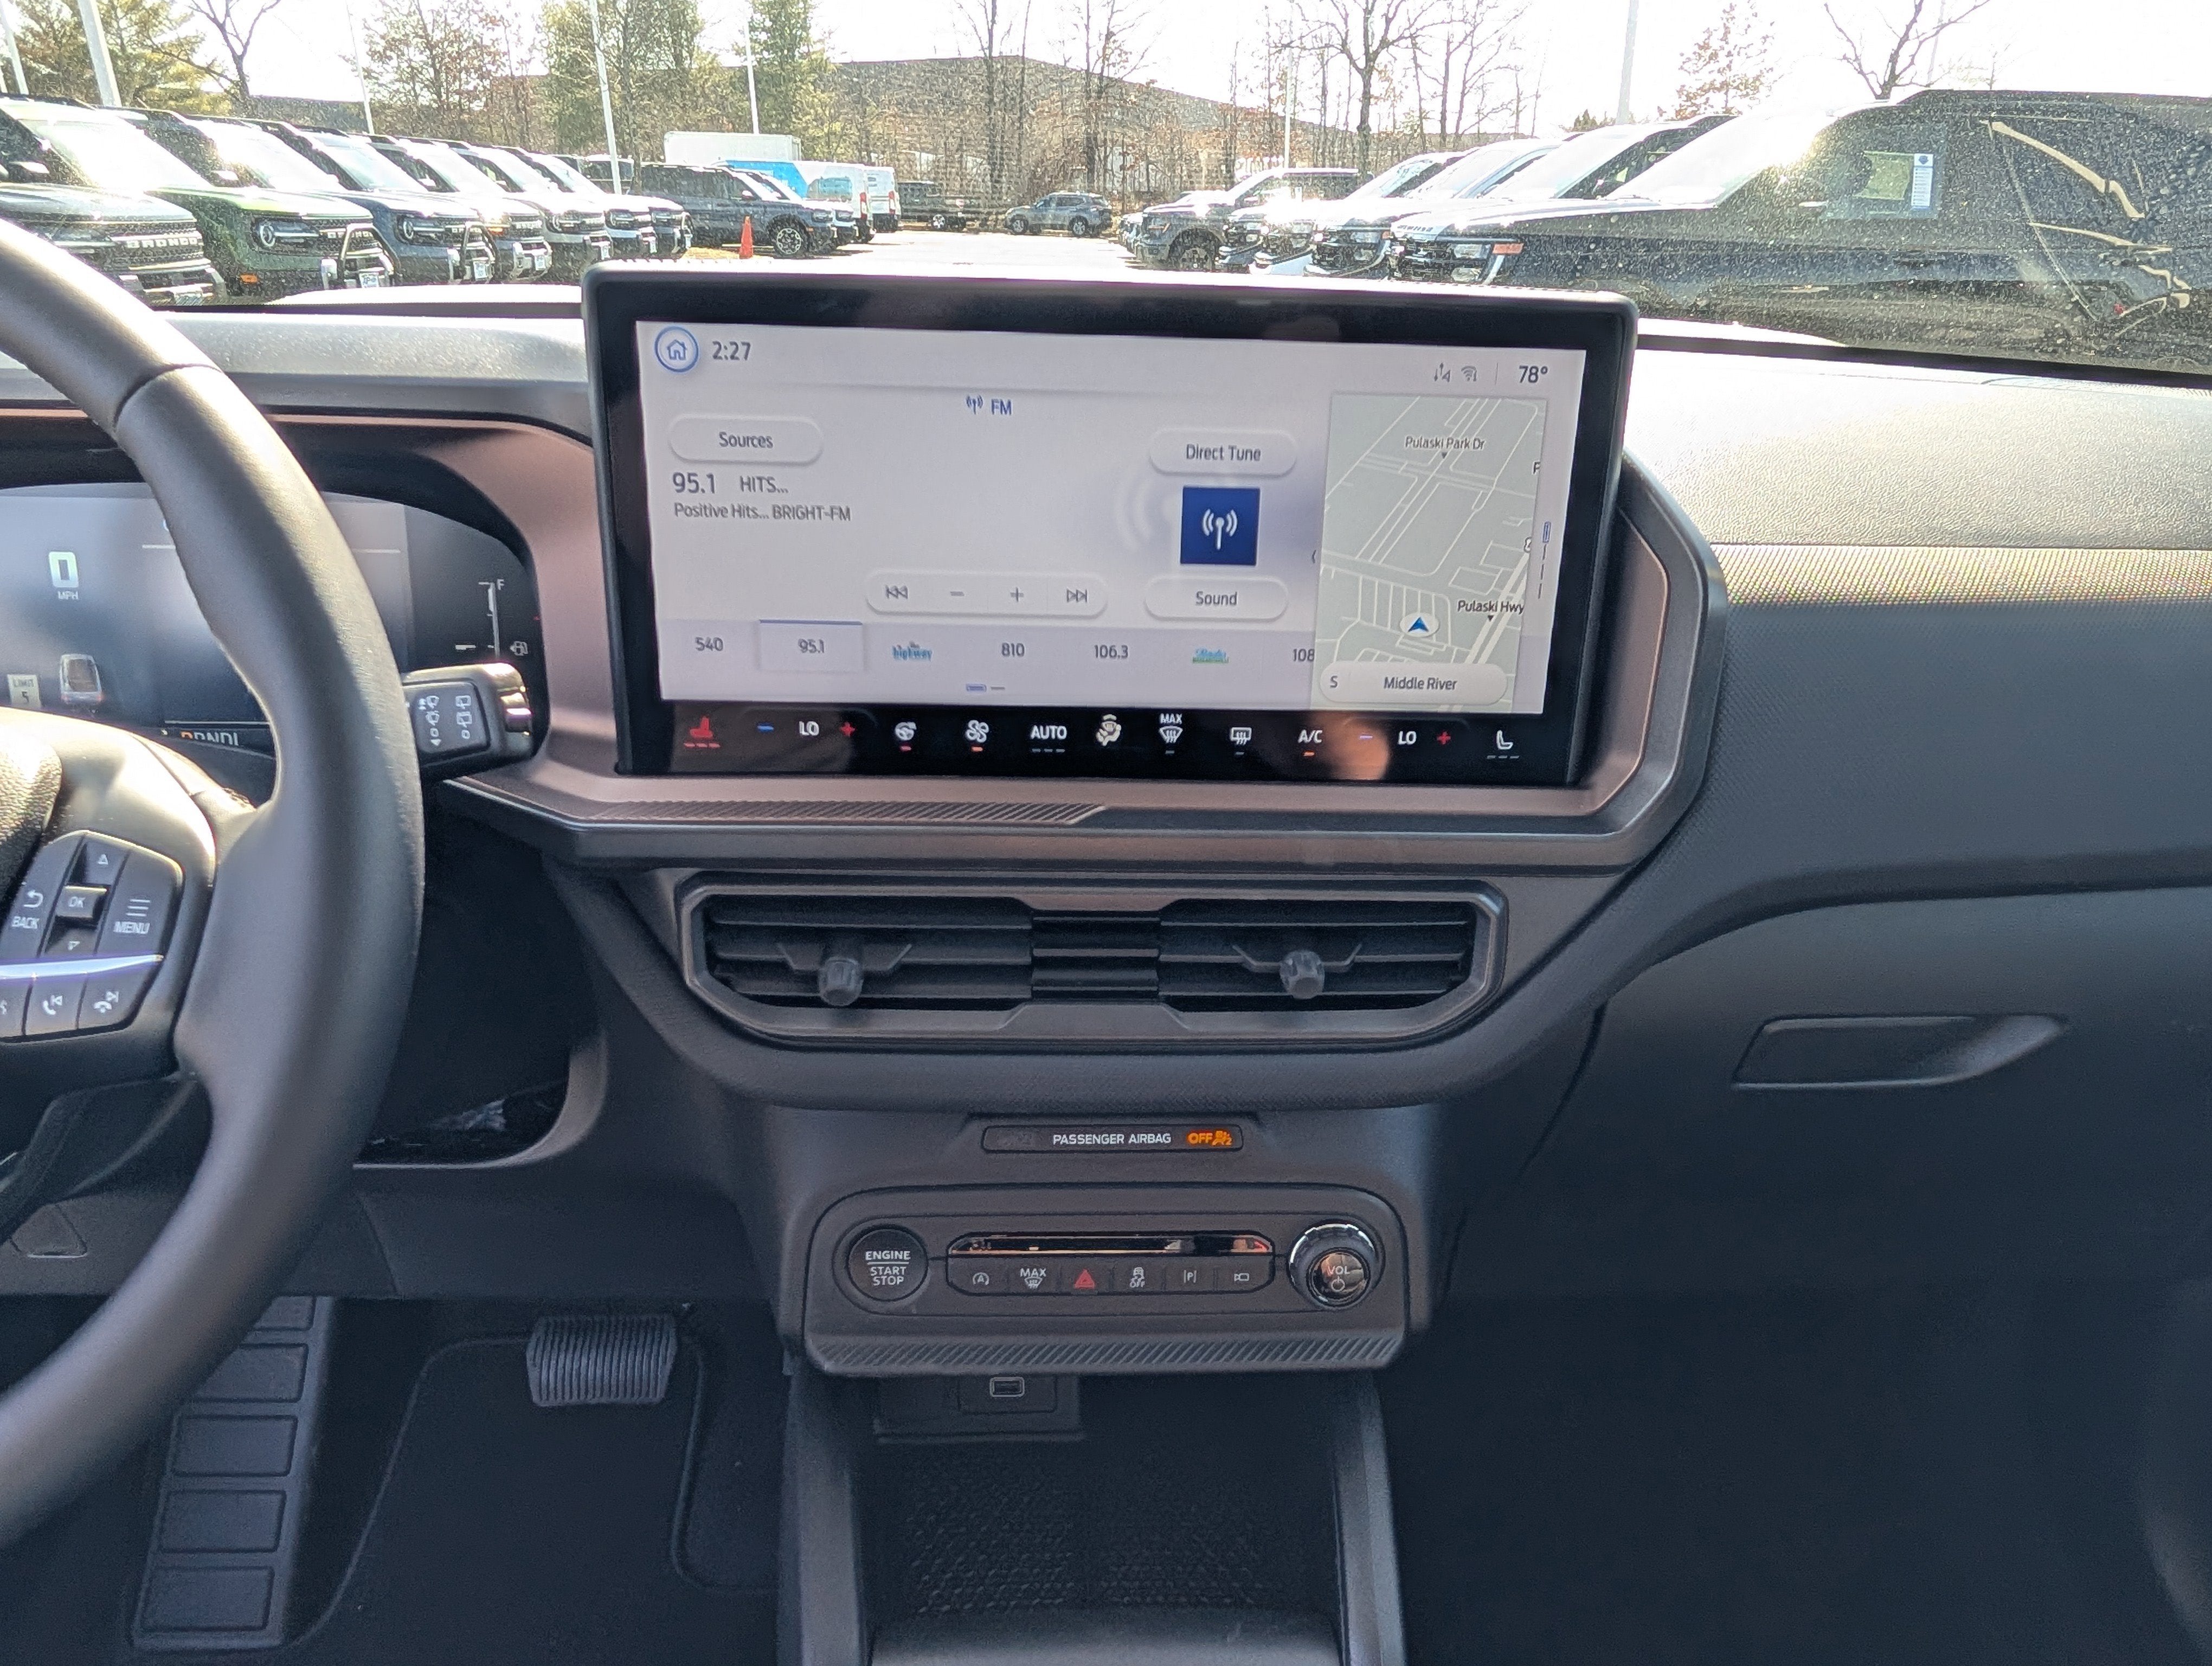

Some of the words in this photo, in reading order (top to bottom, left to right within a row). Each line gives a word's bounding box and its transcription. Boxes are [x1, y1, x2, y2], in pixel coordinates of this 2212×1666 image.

[712, 341, 751, 360] 2:27
[1518, 366, 1548, 383] 78°
[991, 399, 1012, 415] FM
[718, 432, 773, 449] Sources
[1405, 435, 1443, 448] Pulaski
[1446, 437, 1469, 449] Park
[1473, 438, 1485, 450] Dr
[1186, 444, 1224, 461] Direct
[1227, 445, 1261, 462] Tune
[672, 471, 716, 494] 95.1
[739, 476, 789, 494] HITS...
[674, 502, 728, 518] Positive
[731, 503, 769, 520] Hits...
[772, 504, 851, 522] BRIGHT-FM
[48, 551, 79, 588] 0
[497, 578, 505, 591] F
[57, 591, 78, 600] MPH
[1195, 591, 1238, 606] Sound
[1457, 600, 1497, 613] Pulaski
[1500, 601, 1525, 615] Hwy
[695, 636, 724, 652] 540
[798, 638, 825, 654] 95.1
[1001, 643, 1025, 658] 810
[1094, 644, 1129, 659] 106.3
[1293, 648, 1315, 662] 108
[1330, 676, 1339, 689] S
[1383, 676, 1425, 690] Middle
[1427, 677, 1457, 691] River
[1160, 713, 1182, 725] MAX
[799, 721, 820, 736] LO
[1031, 725, 1068, 740] AUTO
[1298, 729, 1323, 744] A/C
[1398, 730, 1417, 746] LO
[68, 896, 86, 908] OK
[11, 916, 40, 930] BACK
[113, 921, 151, 935] MENU
[1053, 1134, 1125, 1146] PASSENGER
[1128, 1133, 1172, 1145] AIRBAG
[1187, 1132, 1213, 1144] OFF
[865, 1250, 911, 1261] ENGINE
[870, 1266, 906, 1276] START
[1020, 1268, 1046, 1277] MAX
[1327, 1266, 1350, 1276] VOL
[872, 1276, 904, 1286] STOP
